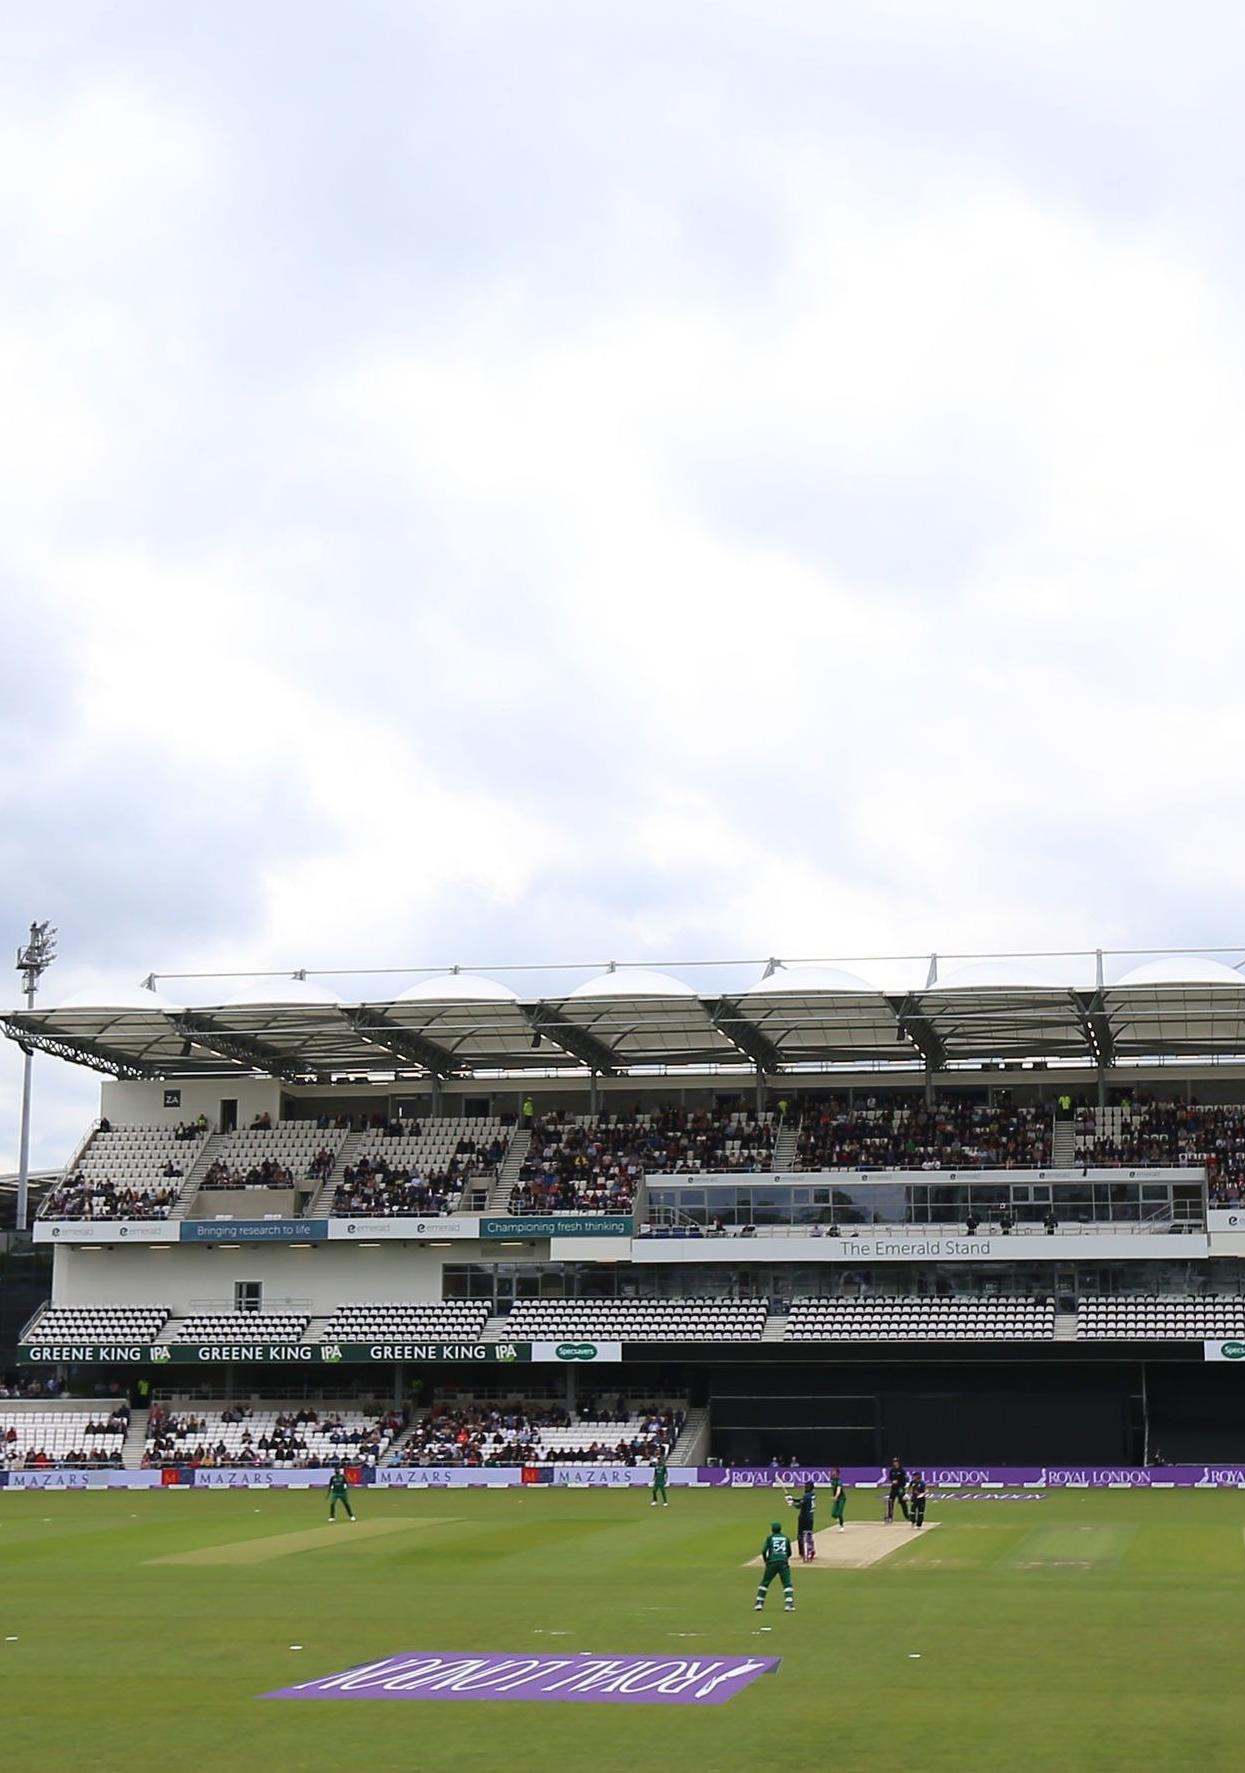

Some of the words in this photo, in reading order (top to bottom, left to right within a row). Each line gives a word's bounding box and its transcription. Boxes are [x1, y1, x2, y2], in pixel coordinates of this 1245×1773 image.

[166, 1095, 179, 1104] ZA
[197, 1226, 237, 1238] Bringing
[239, 1226, 281, 1236] research
[283, 1226, 294, 1235] to
[296, 1225, 311, 1234] life
[487, 1222, 555, 1234] Championing
[558, 1222, 582, 1231] fresh
[585, 1222, 624, 1233] thinking
[840, 1241, 870, 1256] The
[876, 1241, 940, 1256] Emerald
[945, 1240, 990, 1255] Stand
[29, 1347, 94, 1361] GREENE
[99, 1347, 141, 1361] KING
[150, 1346, 171, 1361] IPA
[198, 1347, 263, 1360] GREENE
[269, 1347, 312, 1360] KING
[321, 1345, 342, 1360] IPA
[370, 1346, 436, 1359] GREENE
[443, 1346, 486, 1359] KING
[495, 1344, 517, 1360] IPA
[558, 1346, 595, 1356] Specsavers
[14, 1473, 89, 1485] MAZARS
[200, 1472, 274, 1484] MAZARS
[380, 1472, 452, 1484] MAZARS
[558, 1471, 632, 1483] MAZARS
[732, 1471, 771, 1483] ROYAL
[773, 1471, 831, 1483] LONDON
[931, 1471, 989, 1483] LONDON
[1048, 1471, 1091, 1482] ROYAL
[1093, 1471, 1151, 1482] LONDON
[772, 1540, 787, 1552] 54
[291, 1658, 575, 1692] LONDON
[540, 1660, 726, 1694] ROYAL
